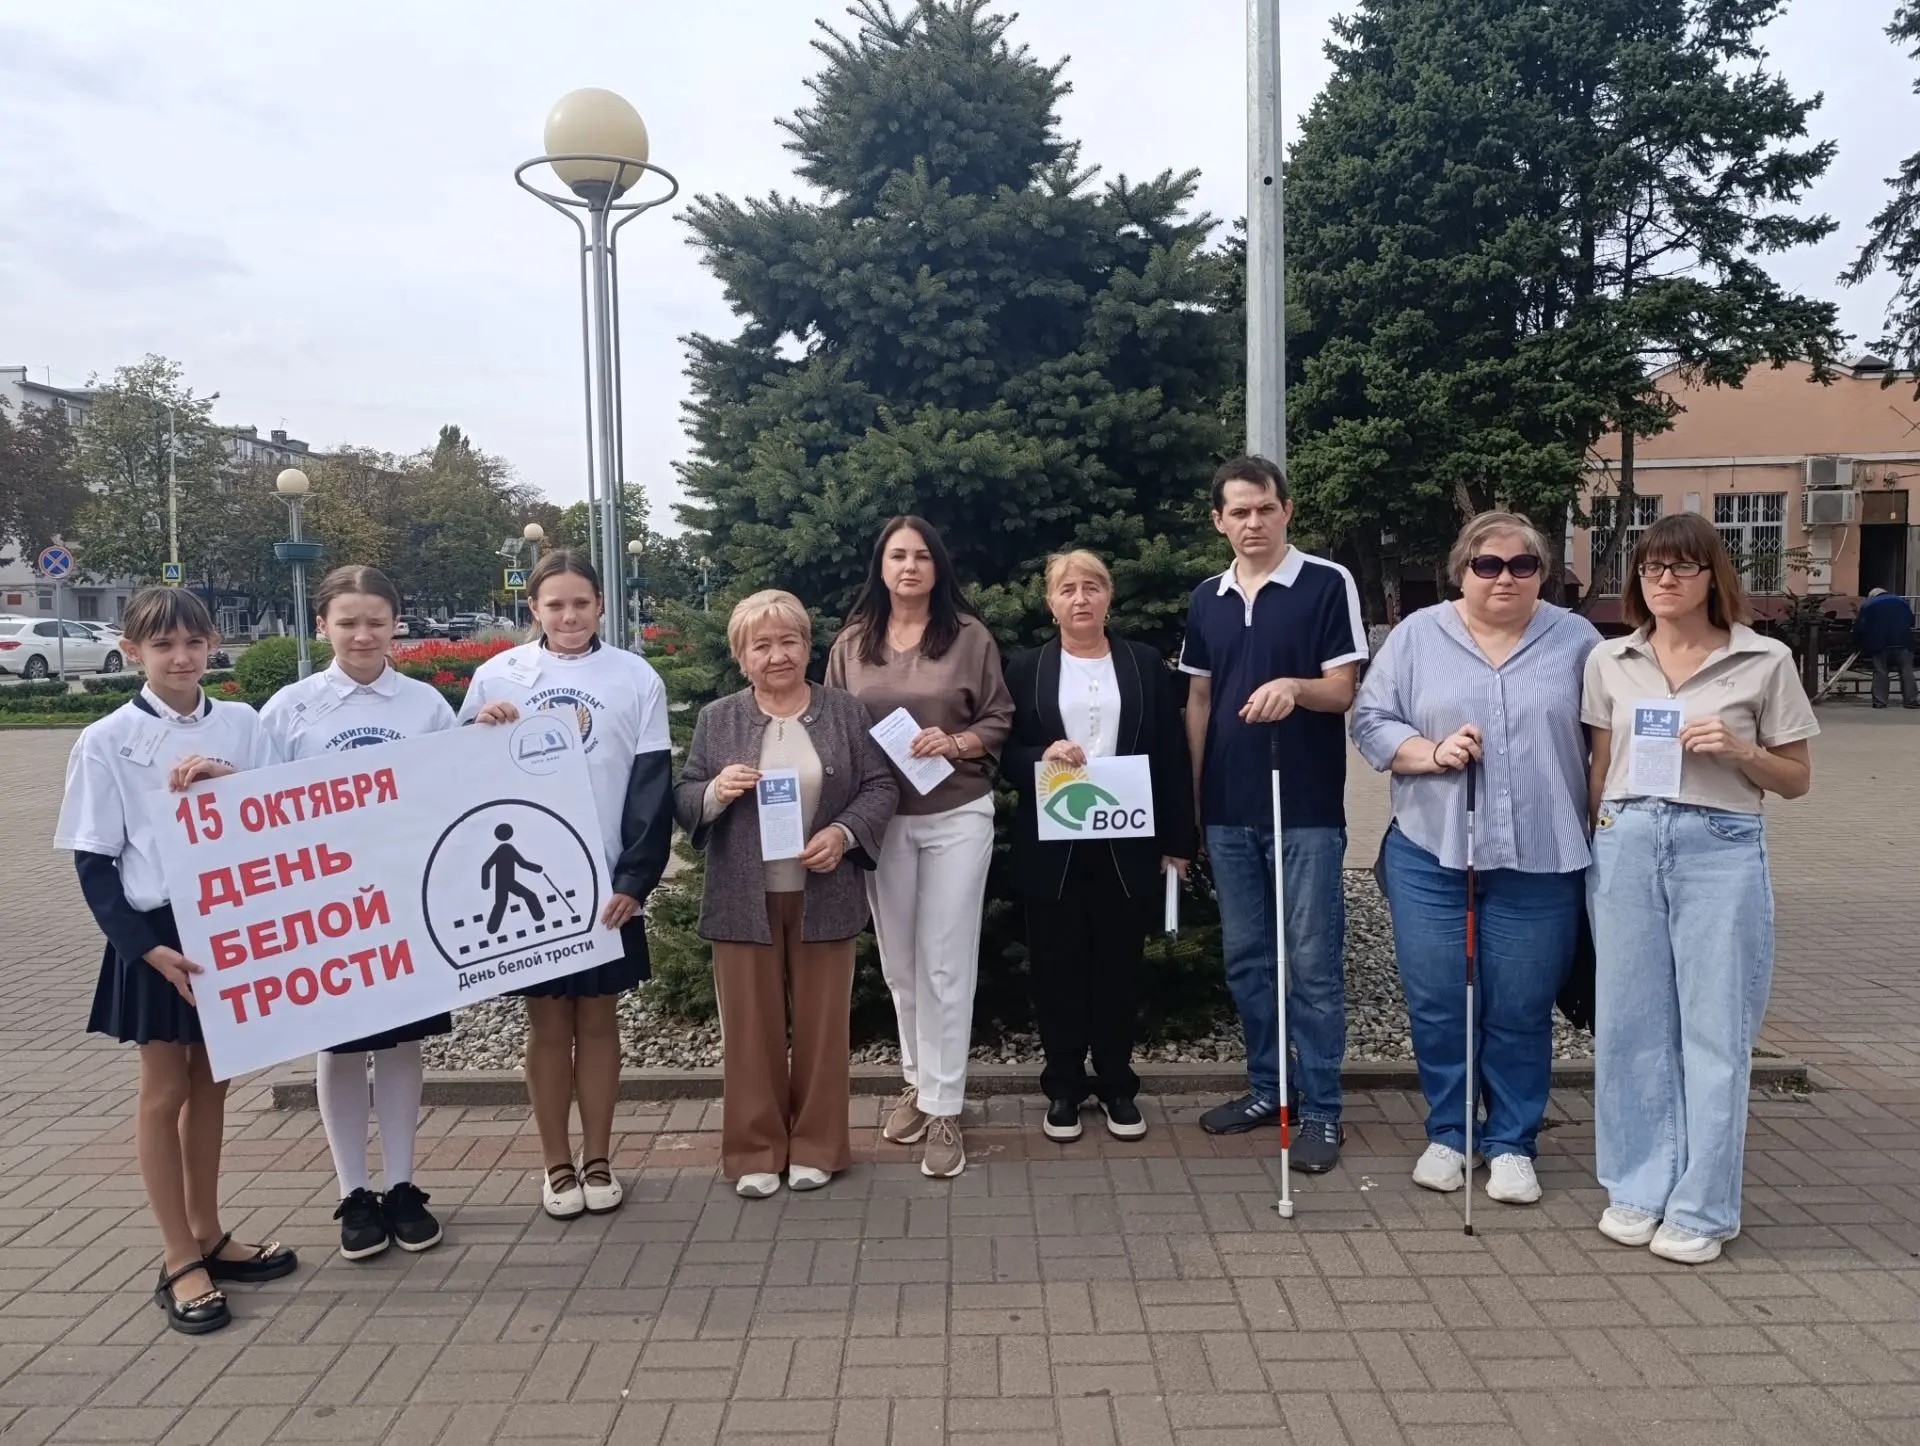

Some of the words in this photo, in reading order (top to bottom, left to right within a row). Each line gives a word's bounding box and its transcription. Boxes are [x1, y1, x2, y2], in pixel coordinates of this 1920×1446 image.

[175, 791, 223, 845] 15
[239, 767, 398, 833] ОКТЯБРЯ
[1092, 808, 1147, 831] ВОС
[197, 842, 352, 916] ДЕНЬ
[209, 883, 391, 971] БЕЛОЙ
[219, 938, 415, 1024] ТРОСТИ
[458, 968, 496, 992] День
[497, 951, 543, 976] белой
[544, 939, 595, 964] трости
